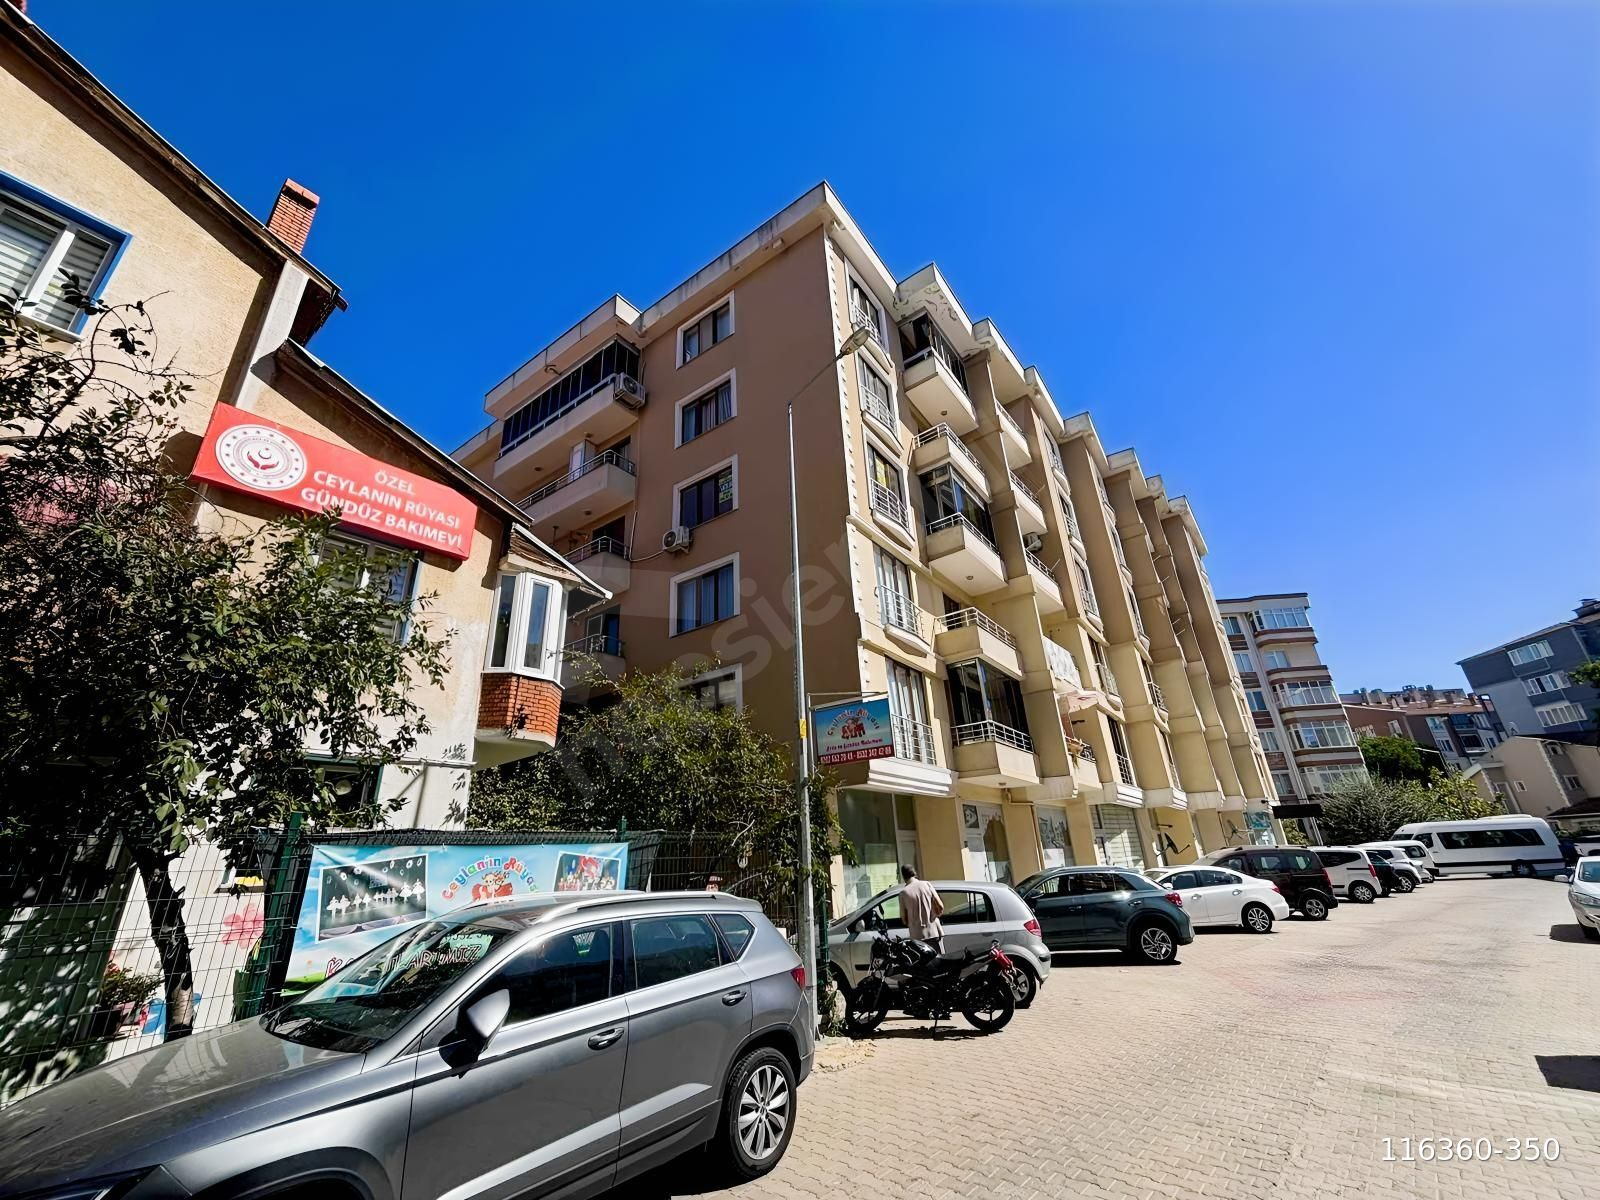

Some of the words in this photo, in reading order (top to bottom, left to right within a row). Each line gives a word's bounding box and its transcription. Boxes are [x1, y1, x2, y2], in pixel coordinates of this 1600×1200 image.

[313, 470, 402, 510] CEYLANIN
[405, 500, 460, 529] RÜYASI
[374, 469, 415, 496] ÖZEL
[301, 487, 383, 523] GÜNDÜZ
[385, 513, 462, 547] BAKIMEVİ
